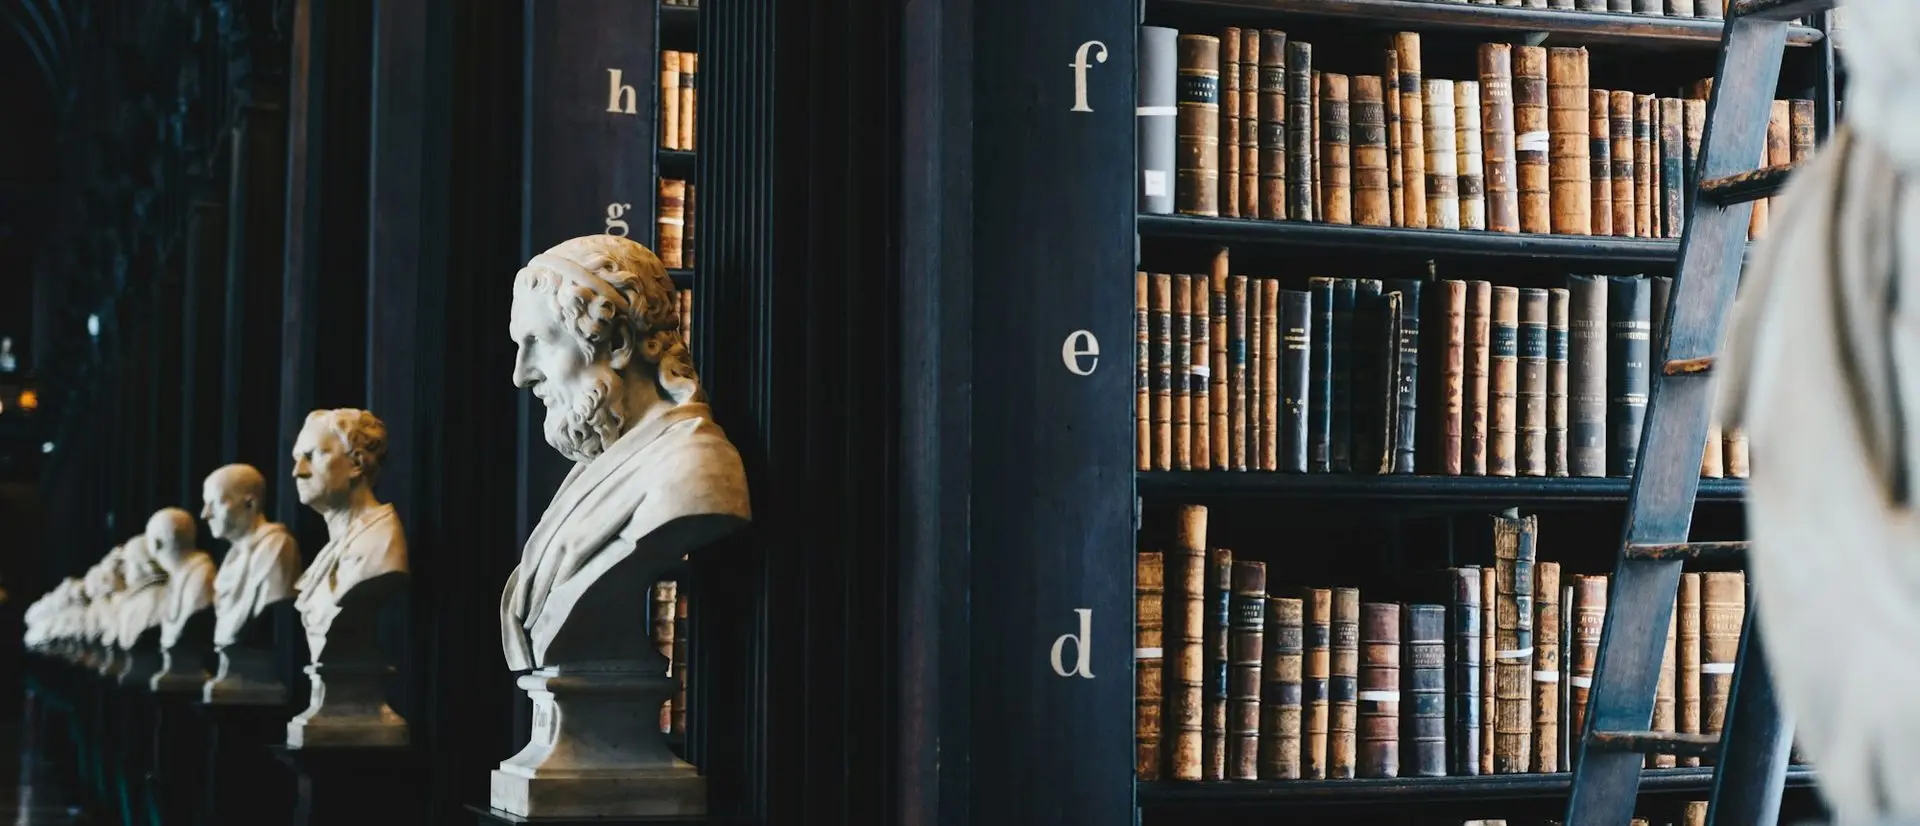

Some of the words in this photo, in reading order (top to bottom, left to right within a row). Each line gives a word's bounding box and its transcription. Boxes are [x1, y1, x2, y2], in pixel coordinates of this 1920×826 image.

[606, 67, 638, 114] h
[1069, 40, 1108, 113] f
[605, 202, 632, 238] g
[1062, 329, 1100, 376] e
[1050, 608, 1096, 678] d
